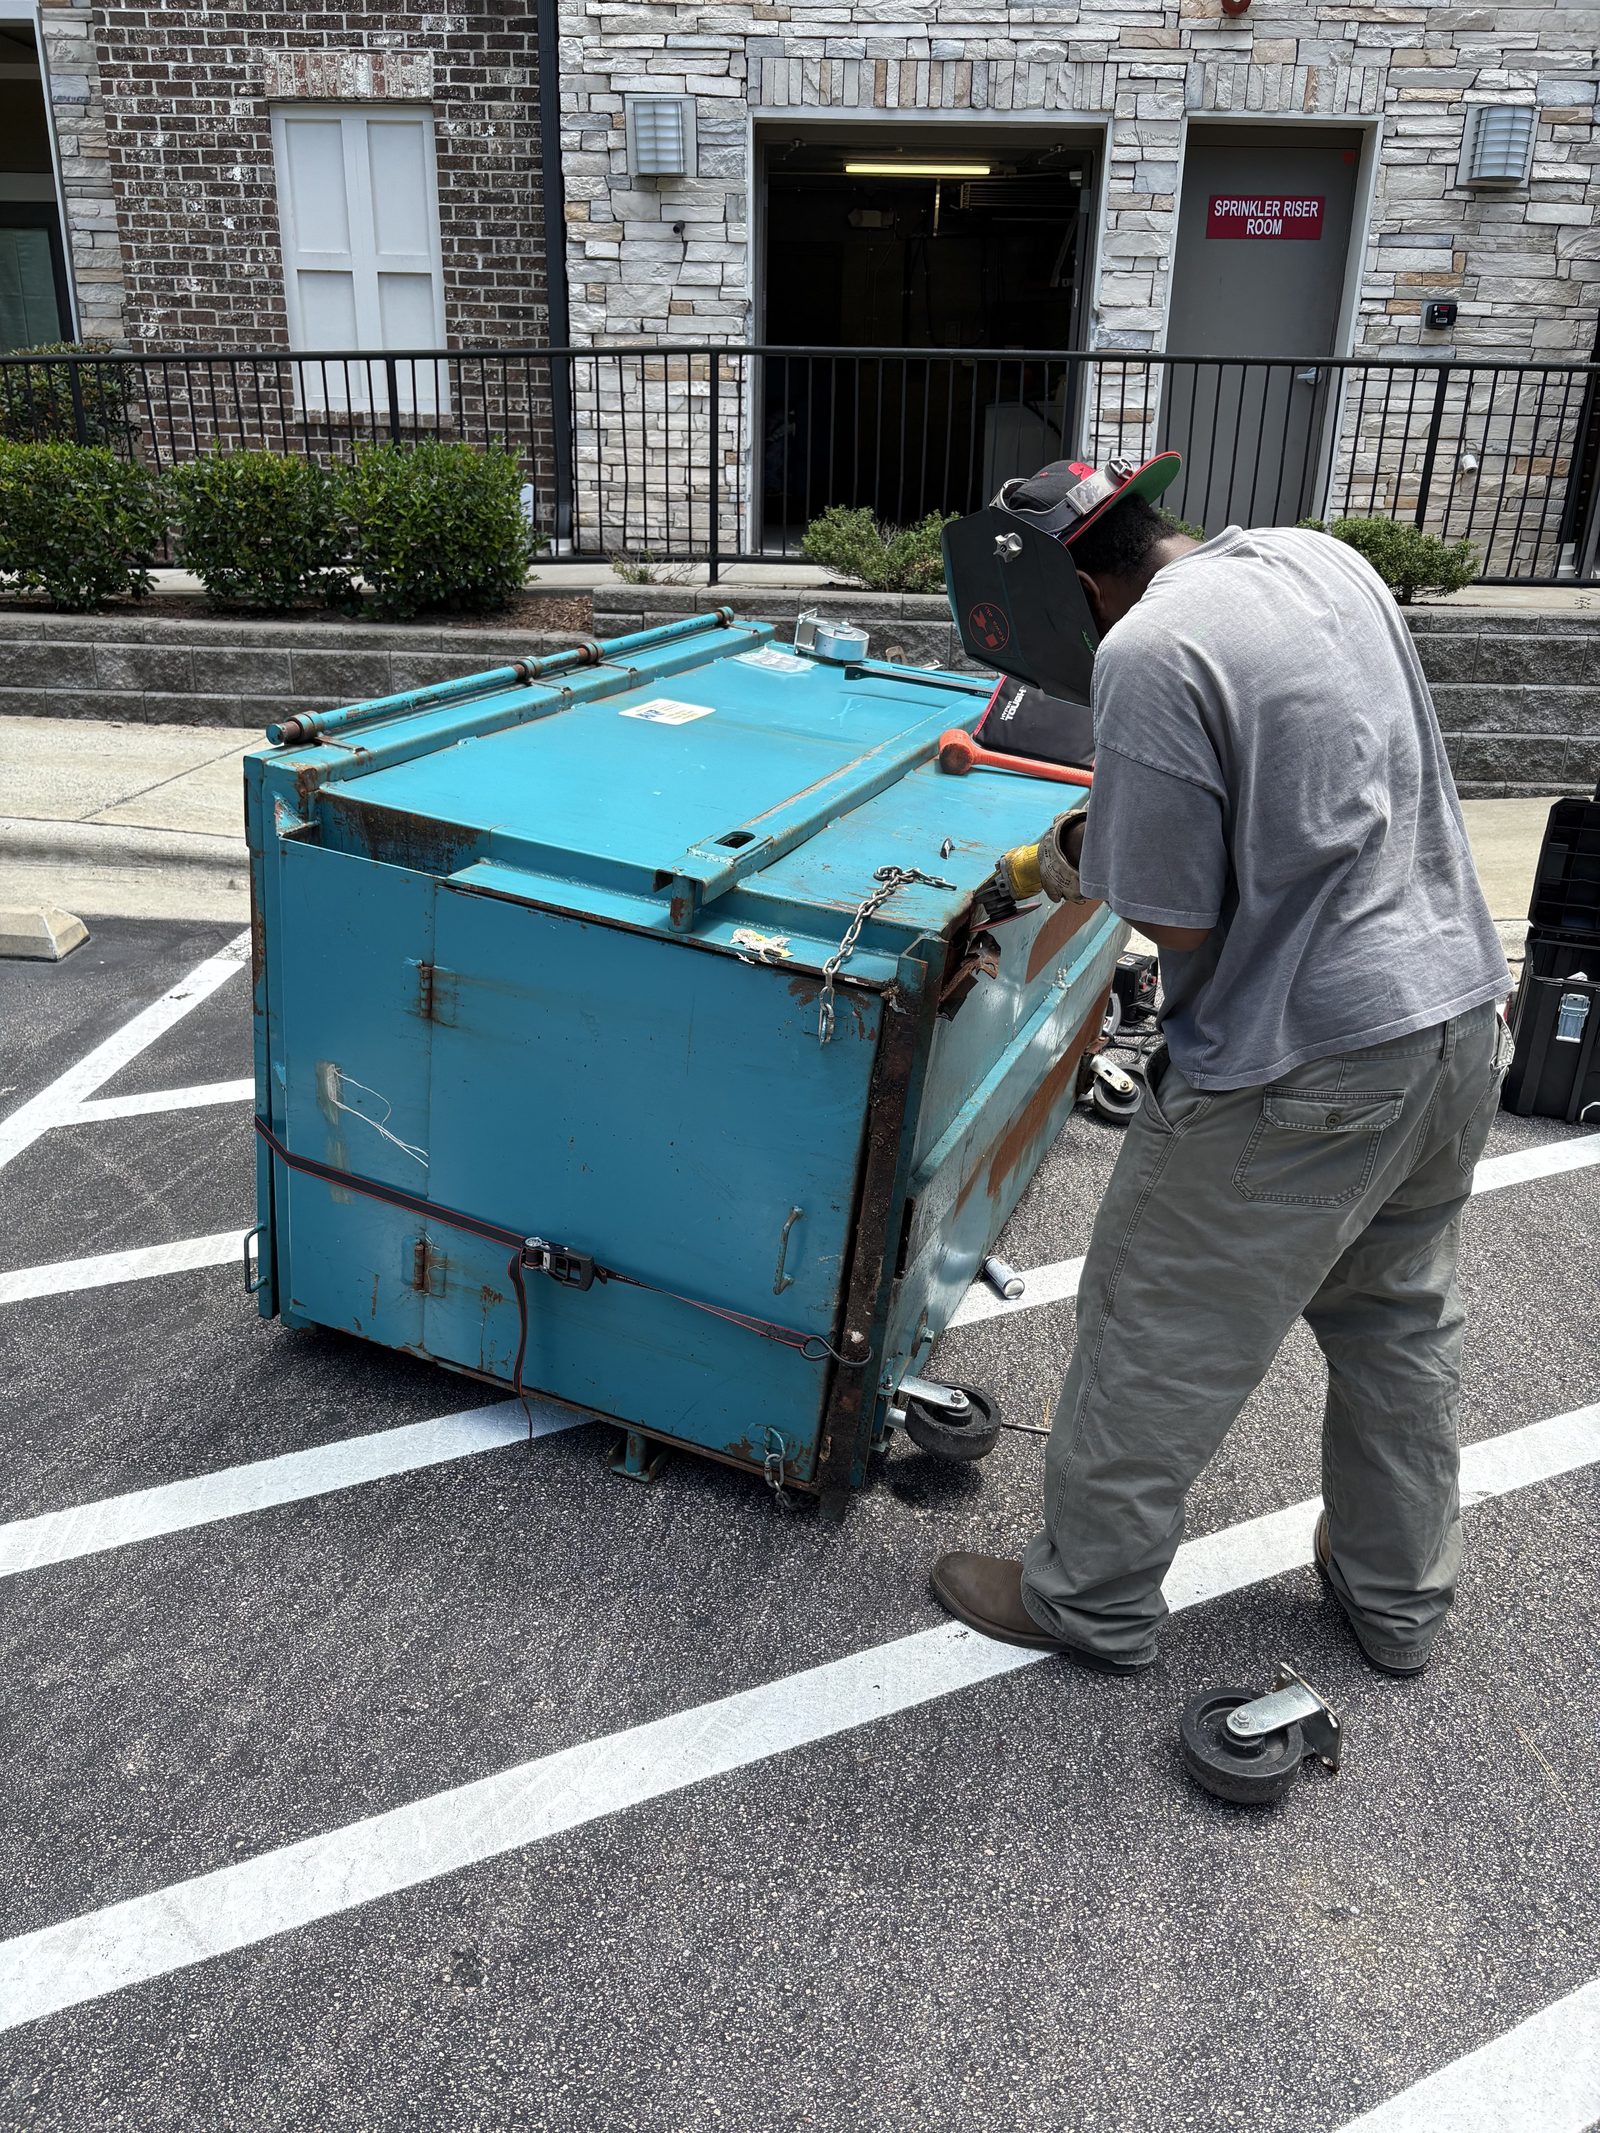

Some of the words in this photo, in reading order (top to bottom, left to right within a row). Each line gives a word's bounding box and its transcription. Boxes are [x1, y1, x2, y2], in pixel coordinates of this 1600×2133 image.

[1214, 199, 1281, 217] SPRINKLER
[1283, 200, 1319, 218] RISER
[1246, 218, 1283, 235] ROOM
[1005, 688, 1027, 720] TOUGH
